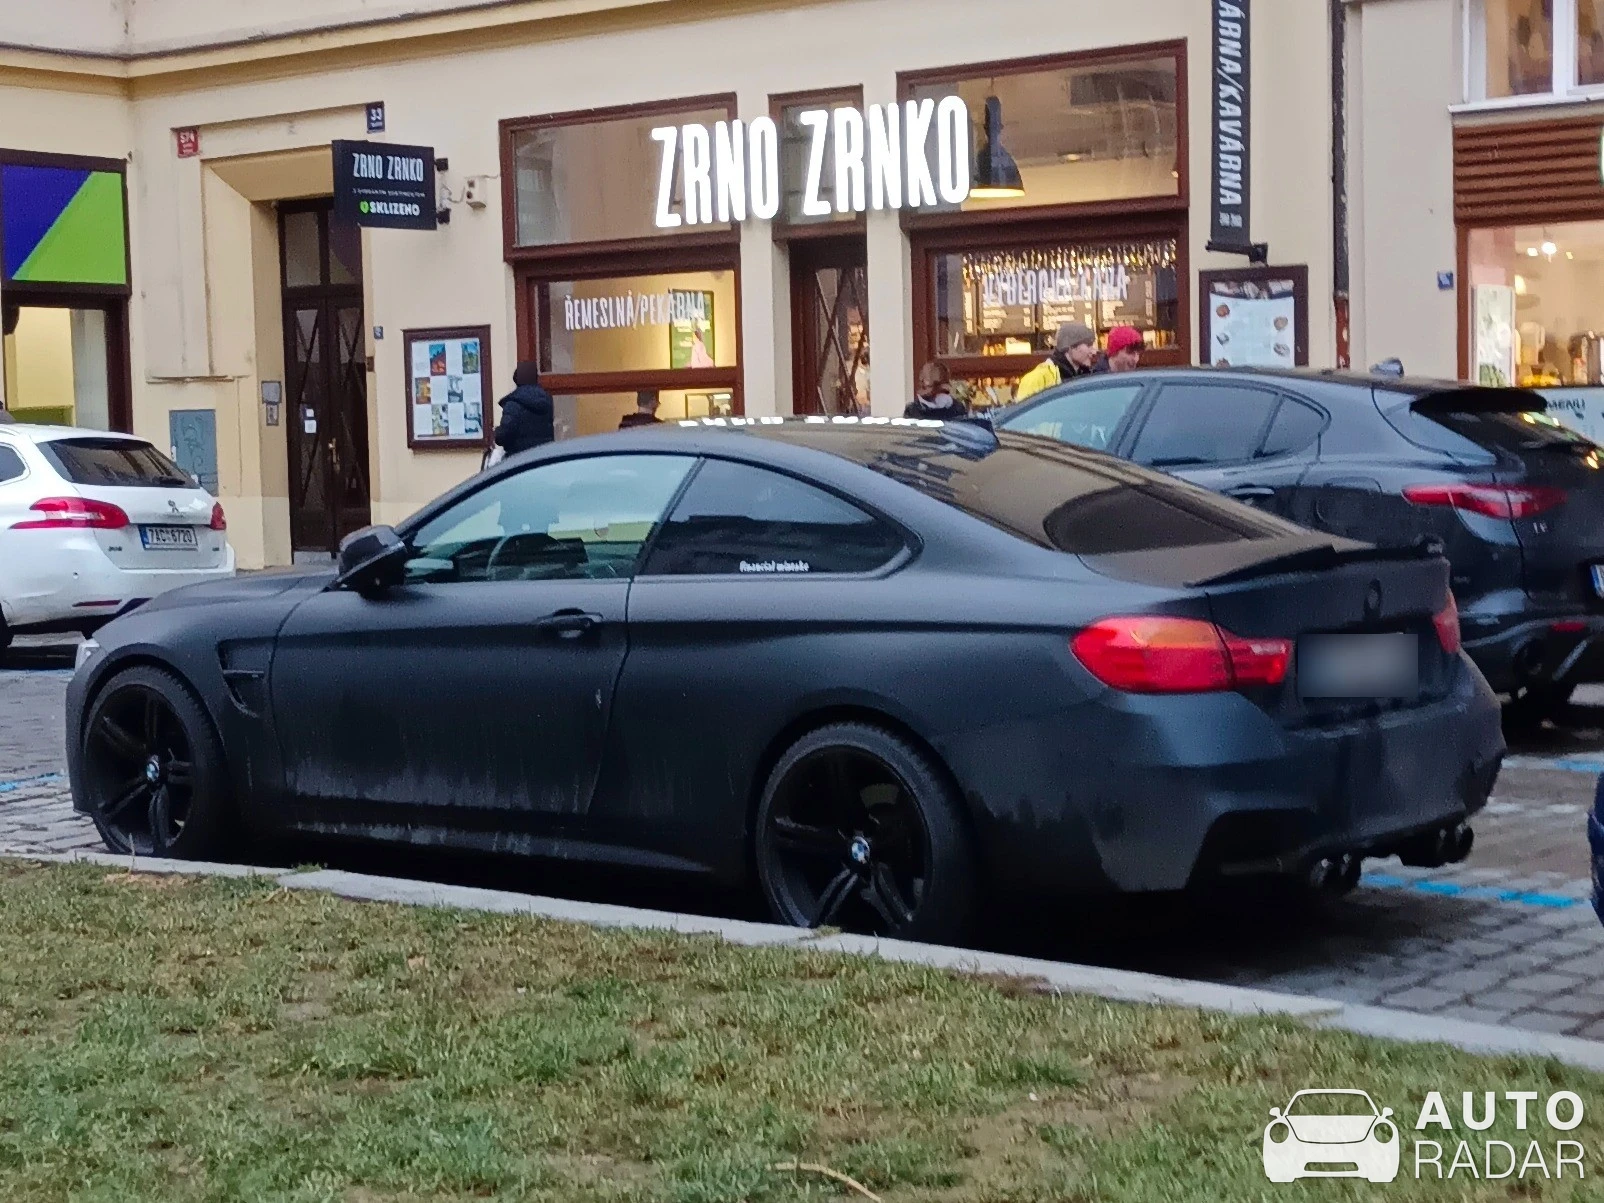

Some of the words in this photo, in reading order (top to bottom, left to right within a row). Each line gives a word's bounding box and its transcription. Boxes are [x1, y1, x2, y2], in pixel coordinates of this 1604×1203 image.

[1217, 0, 1246, 205] ÁRNA/KAVÁRNA
[352, 153, 383, 179] ZRNO
[387, 156, 424, 182] ZRNKO
[651, 116, 779, 228] ZRNO
[800, 95, 970, 216] ZRNKO
[369, 201, 420, 216] SKLIZENO
